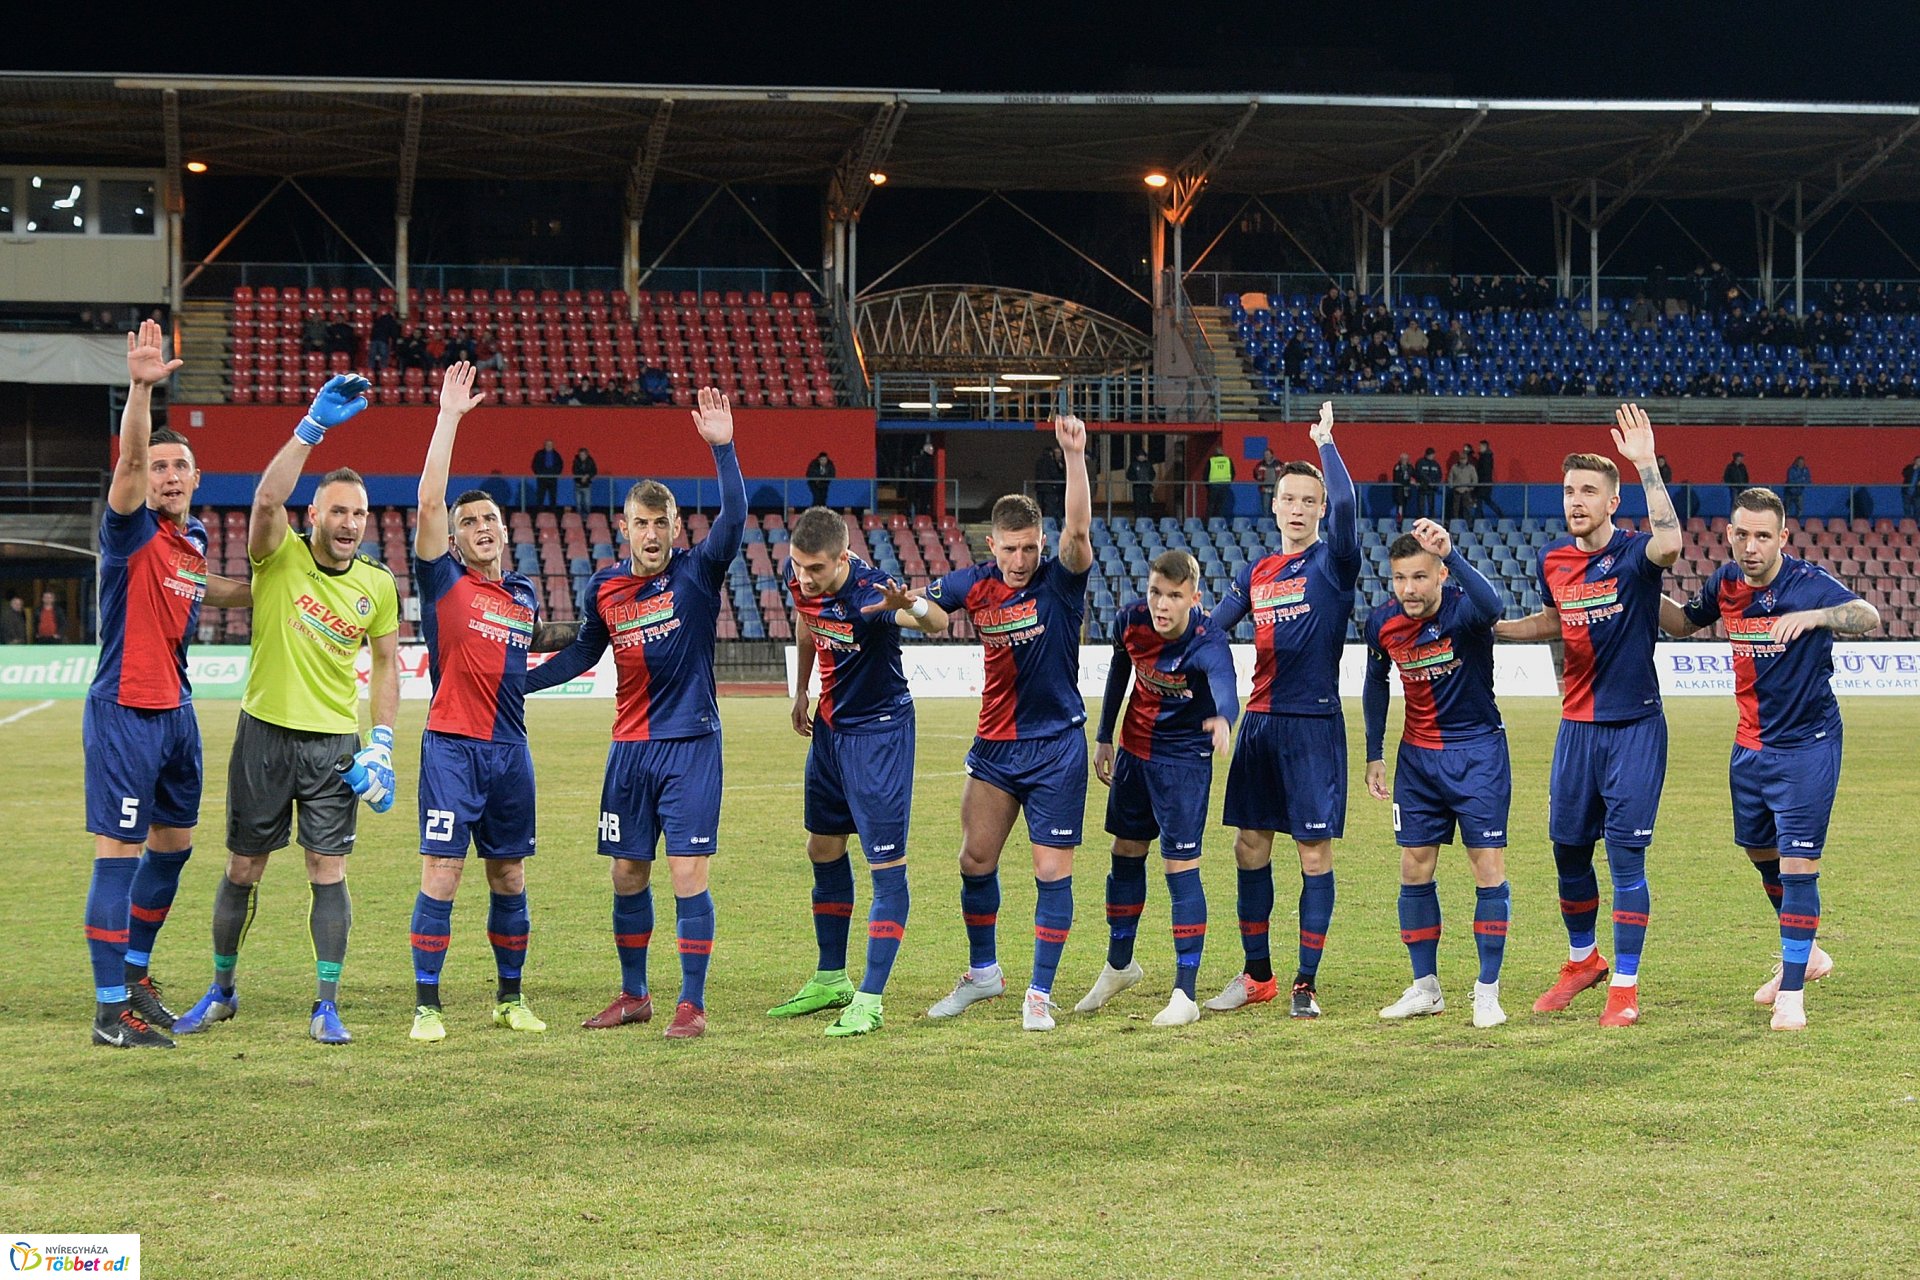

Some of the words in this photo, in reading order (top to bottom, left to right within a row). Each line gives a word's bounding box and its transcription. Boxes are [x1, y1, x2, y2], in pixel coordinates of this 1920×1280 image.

[1553, 577, 1618, 602] REVESZ
[293, 594, 366, 639] REVESZ
[605, 590, 674, 627] REVESZ
[1276, 603, 1311, 618] TRANS
[1589, 603, 1624, 618] TRANS
[645, 618, 681, 637] TRANS
[803, 613, 853, 637] EVESZ
[1754, 644, 1786, 653] TRANS
[188, 662, 239, 677] IGA
[910, 664, 984, 681] AVE
[1137, 662, 1187, 685] EVESZ
[1832, 680, 1872, 689] EMEK
[119, 797, 140, 829] 5
[425, 809, 455, 842] 23
